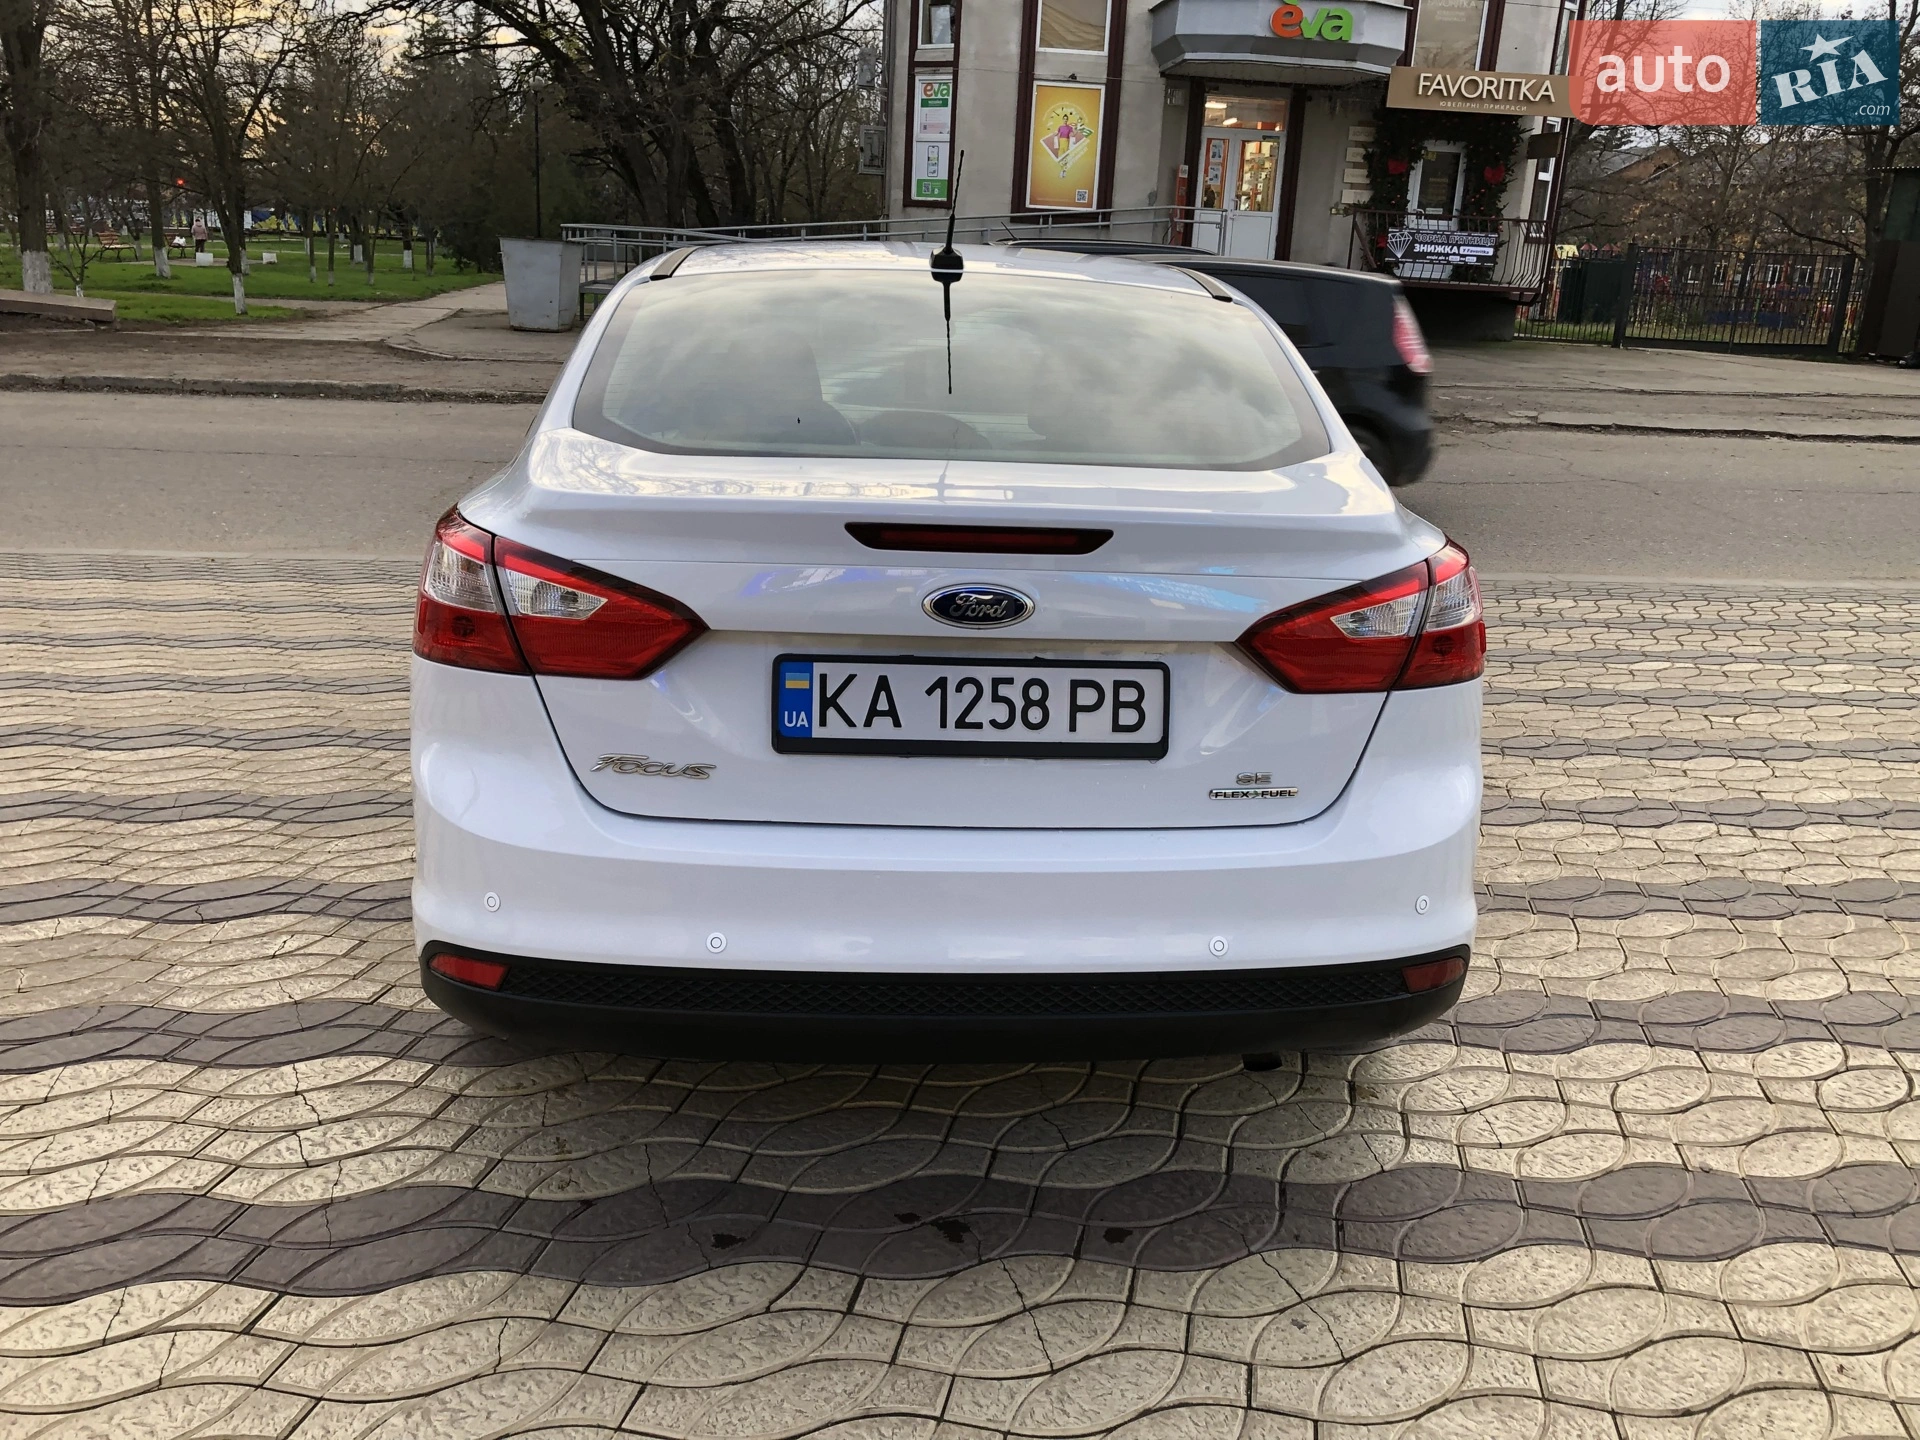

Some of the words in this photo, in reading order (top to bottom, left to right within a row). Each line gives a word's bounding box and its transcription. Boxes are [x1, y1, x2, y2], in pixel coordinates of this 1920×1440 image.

[1269, 4, 1354, 42] eva
[923, 82, 950, 97] eva
[1417, 72, 1556, 103] FAVORITKA
[1439, 101, 1480, 109] ЮВЕЛІРНІ
[1483, 103, 1527, 112] ПРИКРАСИ
[1414, 233, 1447, 244] ЧОРНА
[1413, 243, 1459, 254] ЗНИЖКА
[949, 593, 1008, 619] Ford
[818, 673, 903, 729] KA
[924, 676, 1051, 732] 1258
[1069, 680, 1146, 733] PB
[784, 711, 809, 729] UA
[1236, 772, 1272, 786] SE
[1261, 790, 1296, 798] FUEL
